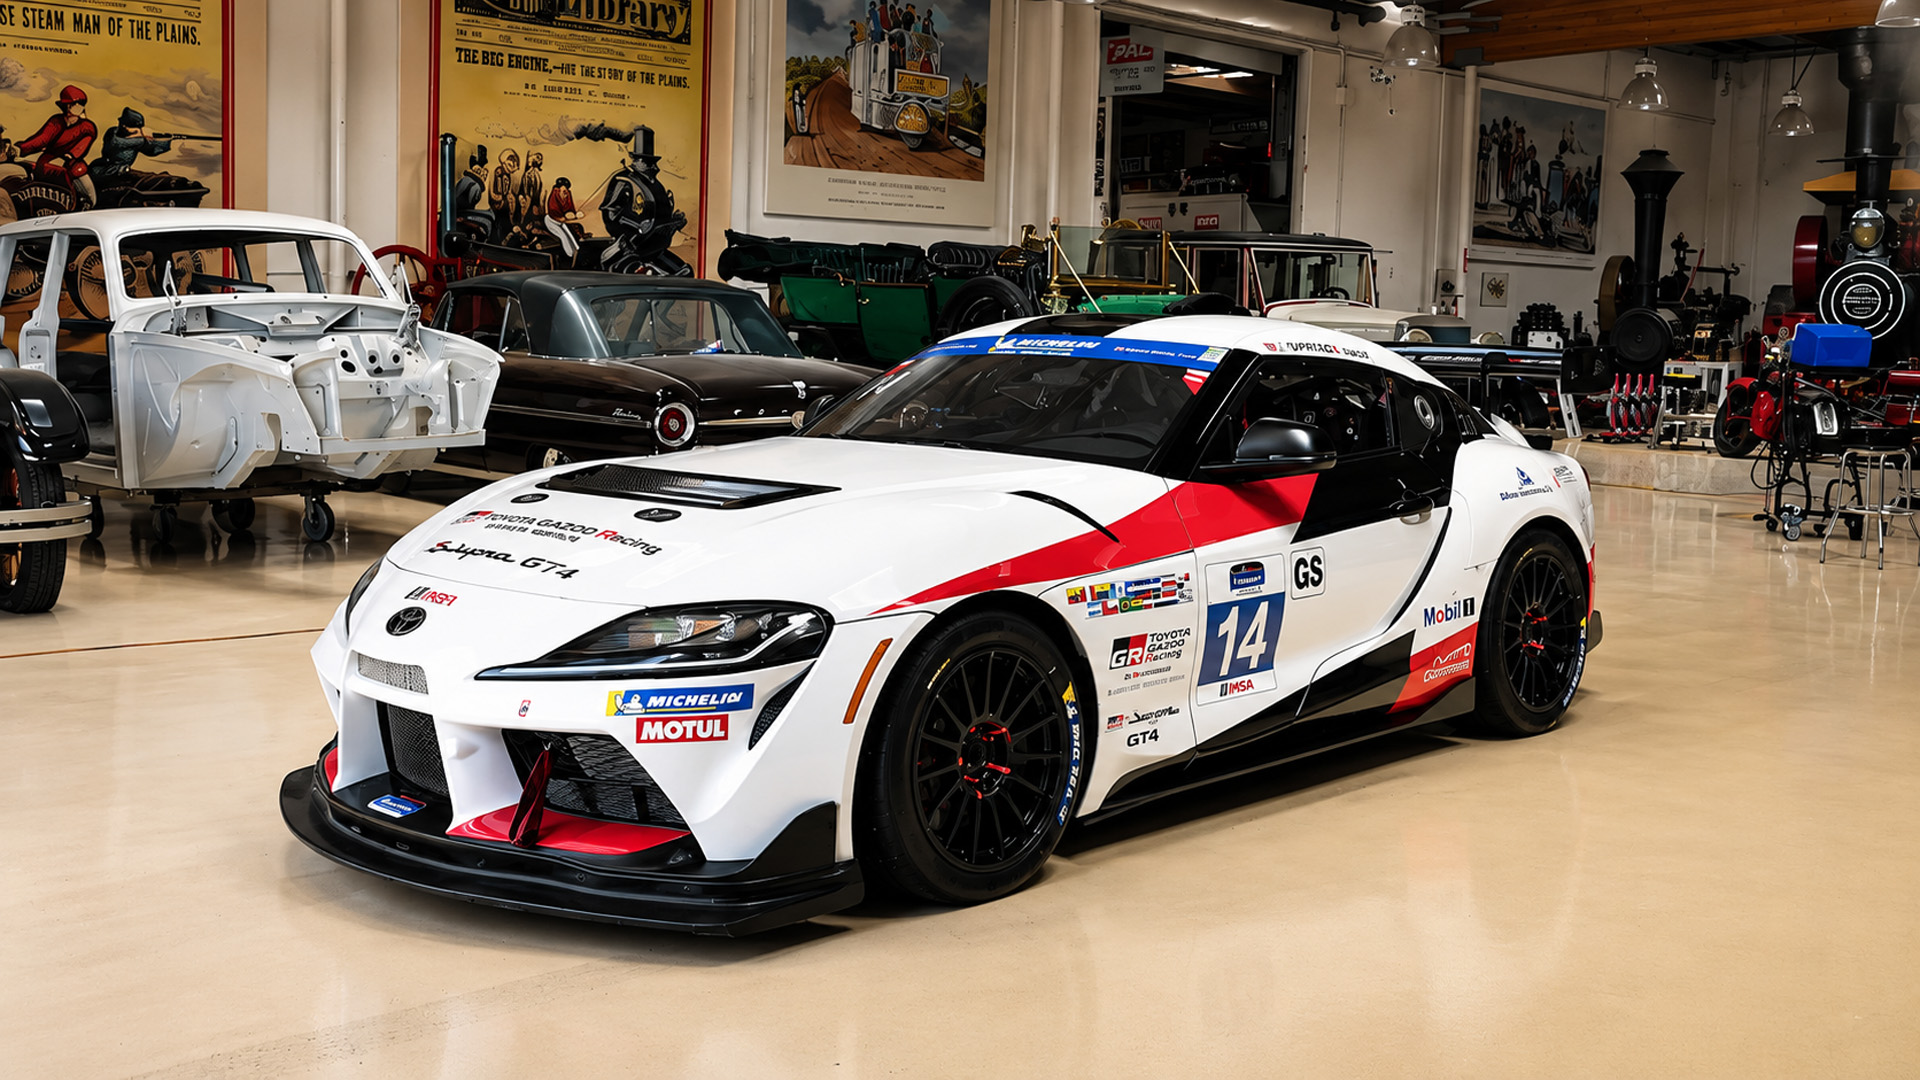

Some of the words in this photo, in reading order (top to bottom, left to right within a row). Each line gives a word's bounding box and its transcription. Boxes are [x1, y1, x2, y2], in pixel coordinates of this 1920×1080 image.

[22, 7, 65, 31] STEAM
[73, 12, 101, 35] MAN
[108, 17, 123, 36] OF
[129, 19, 152, 40] THE
[156, 22, 201, 46] PLAINS.
[455, 47, 479, 64] THE
[519, 556, 580, 580] GT4
[1294, 555, 1323, 590] GS
[1423, 599, 1462, 628] Mobil
[1149, 627, 1191, 642] TOYOTA
[1218, 600, 1268, 677] 14
[1111, 647, 1144, 668] GR
[1228, 679, 1255, 695] IMSA
[639, 719, 726, 741] MOTUL
[1126, 728, 1160, 748] GT4
